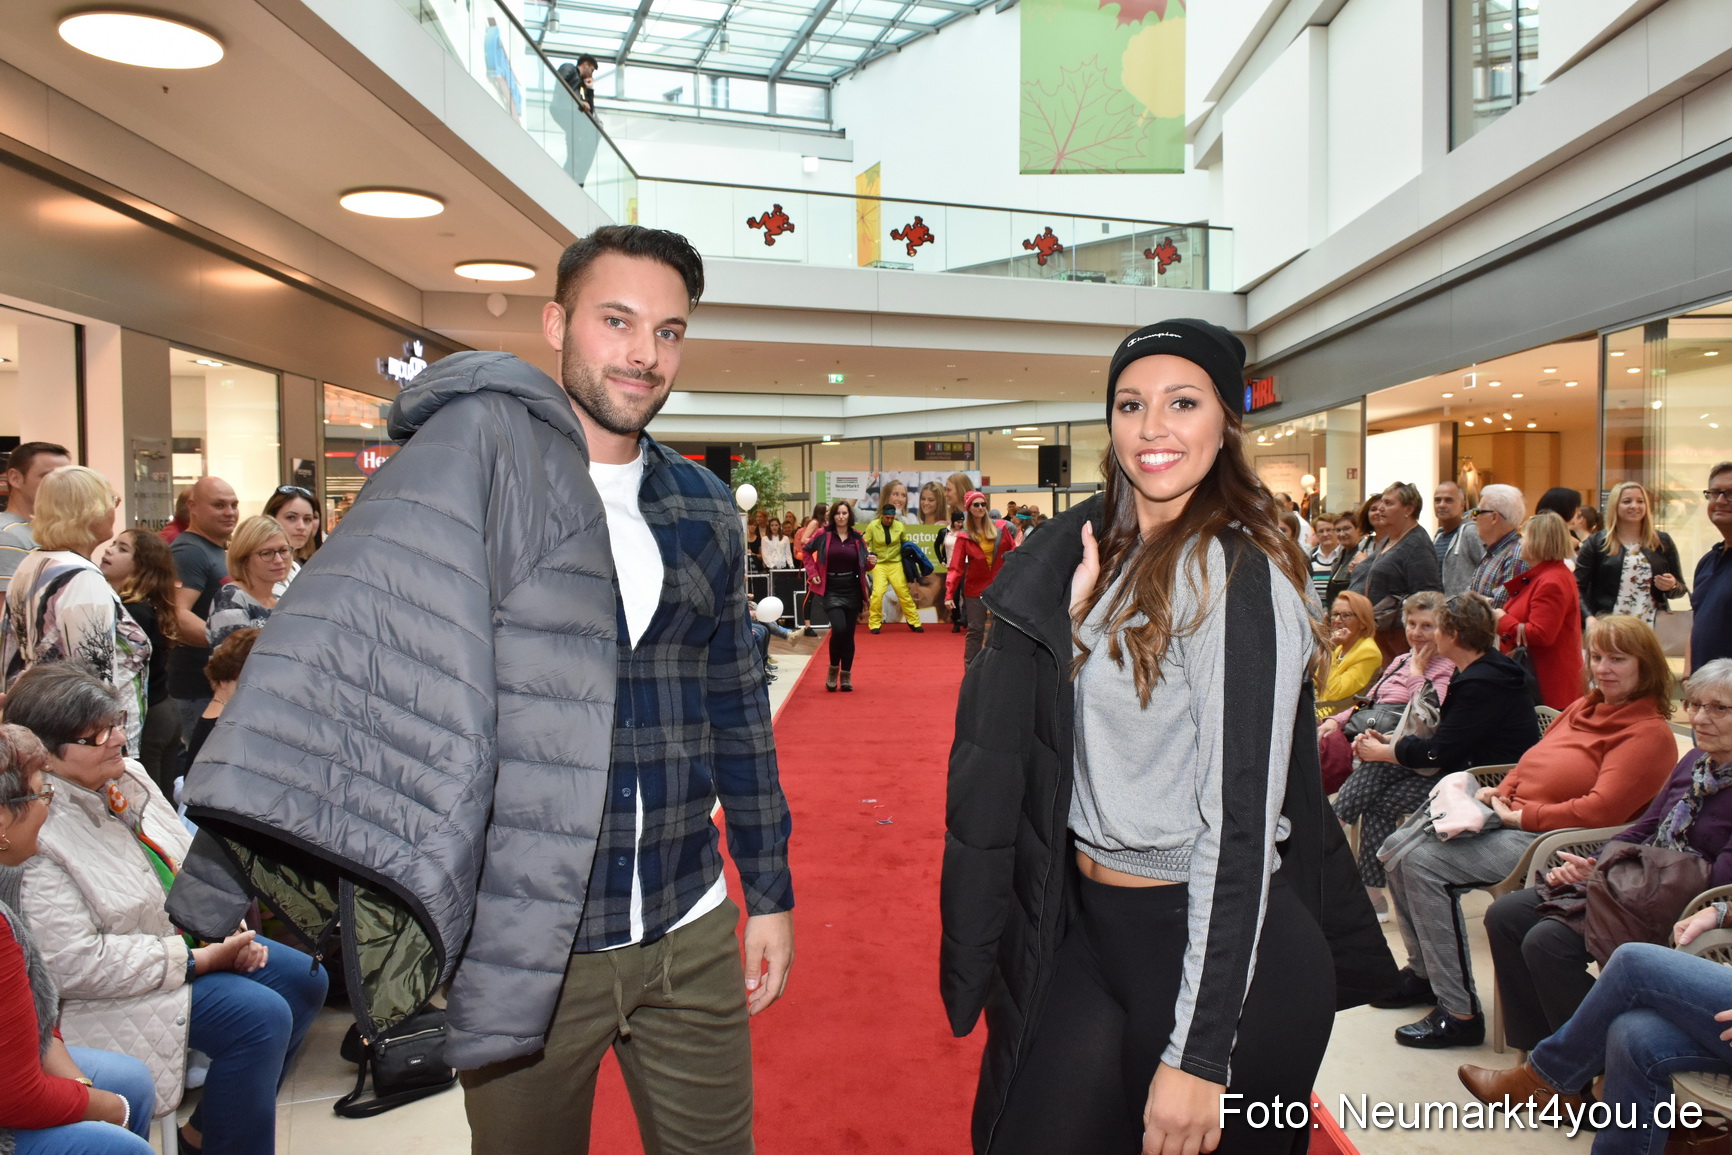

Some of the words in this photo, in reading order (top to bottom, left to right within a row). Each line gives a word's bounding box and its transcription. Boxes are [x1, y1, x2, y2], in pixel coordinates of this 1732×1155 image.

[1127, 331, 1182, 347] Champion
[1244, 375, 1276, 413] ÖHRL
[363, 451, 388, 468] He
[906, 532, 938, 544] ngtou
